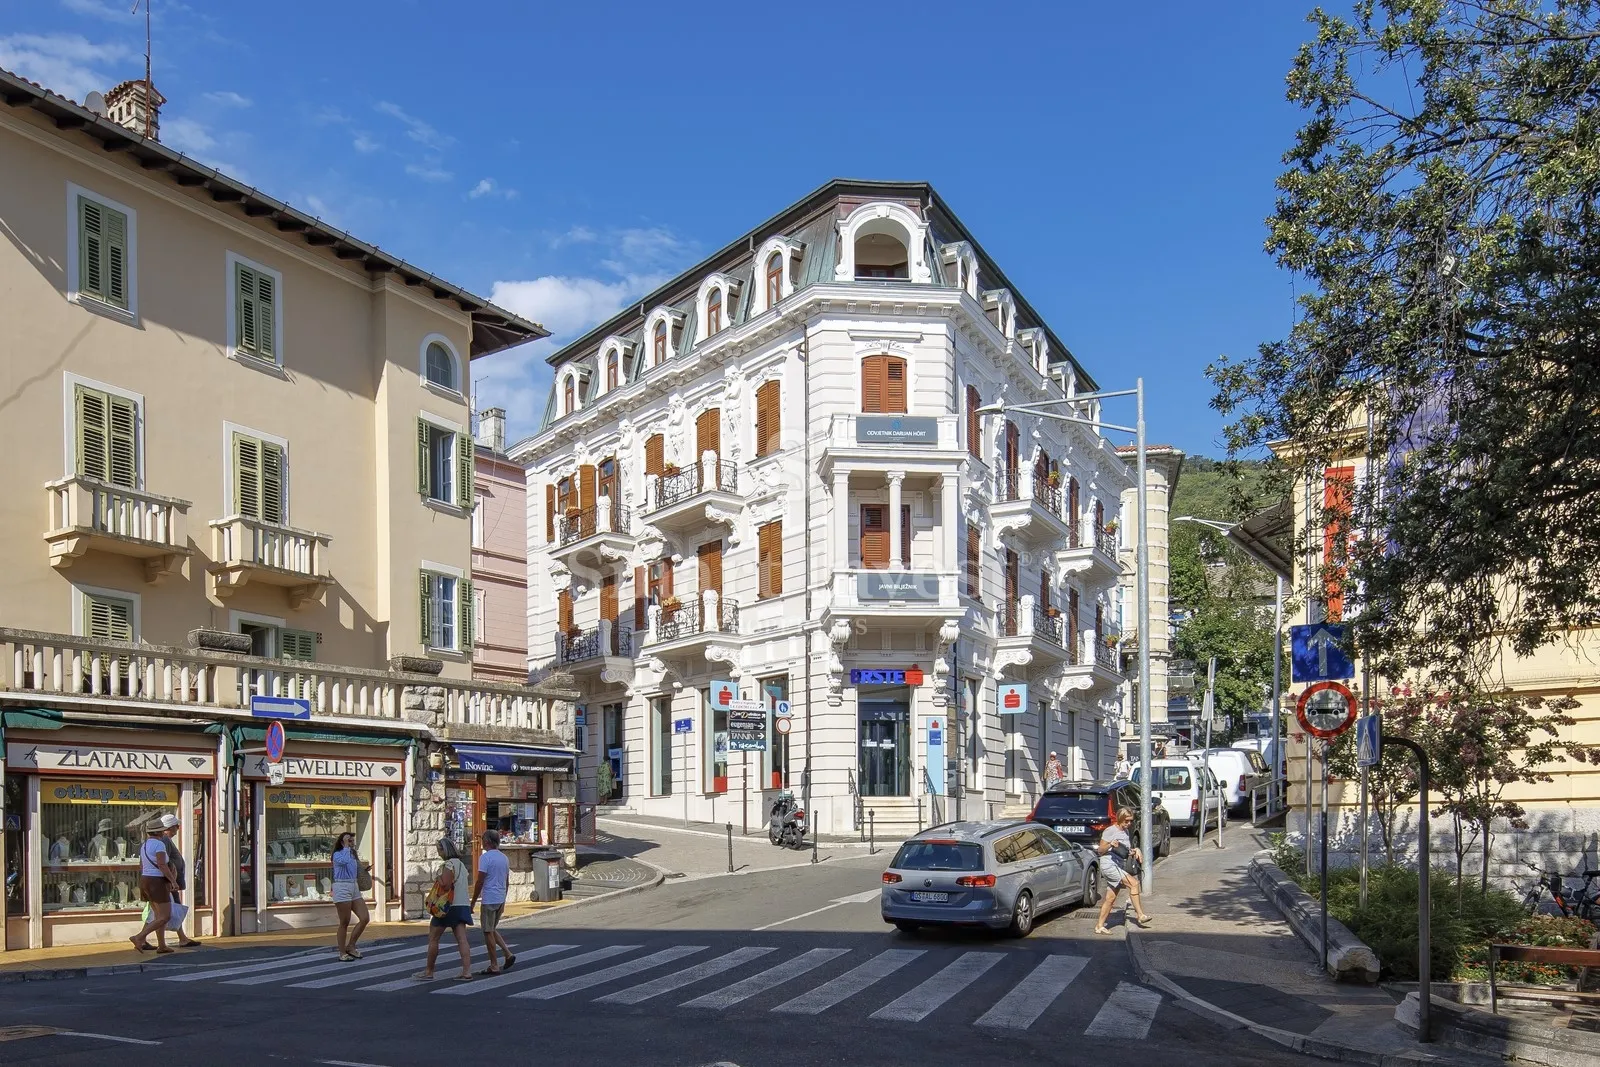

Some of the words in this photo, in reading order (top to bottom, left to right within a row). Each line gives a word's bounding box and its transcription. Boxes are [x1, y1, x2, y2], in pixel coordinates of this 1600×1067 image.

[851, 668, 905, 684] ERSTE
[57, 749, 173, 771] ZLATARNA
[285, 759, 374, 777] EWELLERY
[465, 761, 494, 772] iNovine
[54, 784, 114, 803] otkup
[118, 785, 167, 801] zlata
[269, 790, 316, 807] otkup
